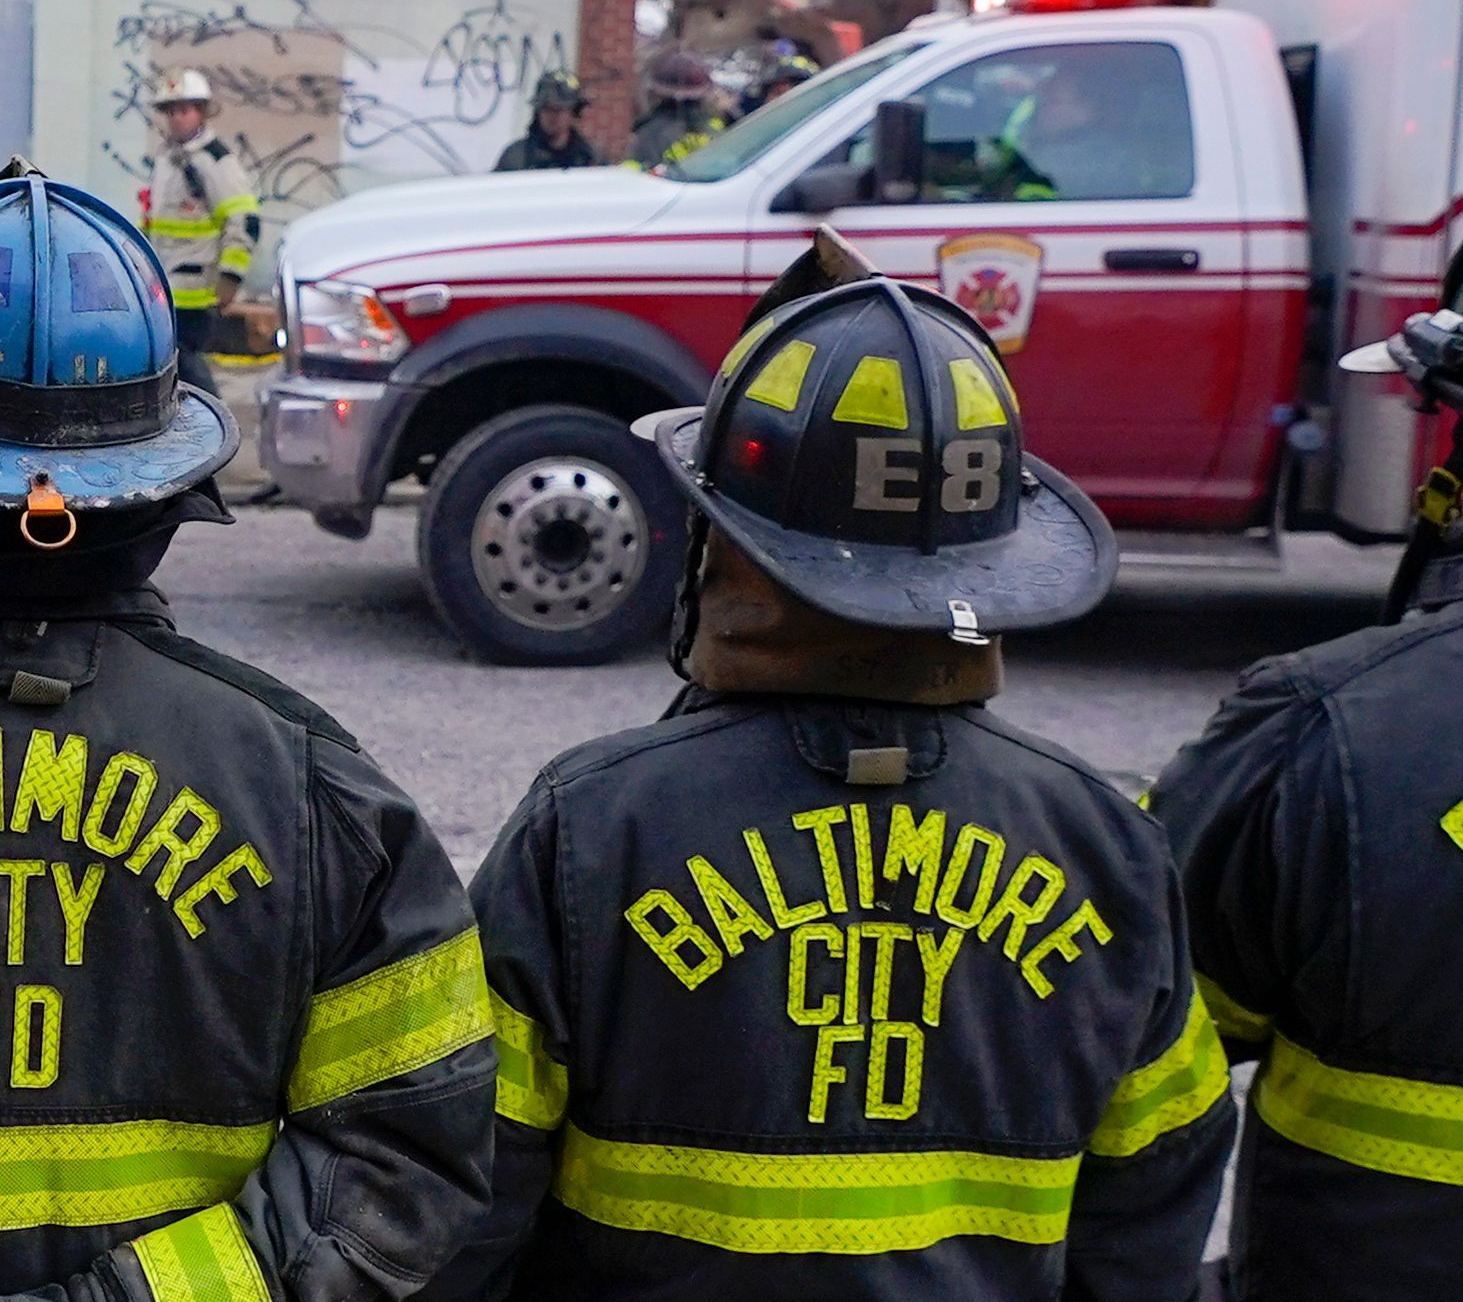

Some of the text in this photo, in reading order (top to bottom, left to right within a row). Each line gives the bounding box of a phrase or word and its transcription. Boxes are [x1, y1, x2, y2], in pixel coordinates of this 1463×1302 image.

[853, 437, 1002, 513] E8
[624, 803, 1114, 999] BALTIMORE
[787, 921, 965, 1027] CITY
[808, 1021, 924, 1123] FD
